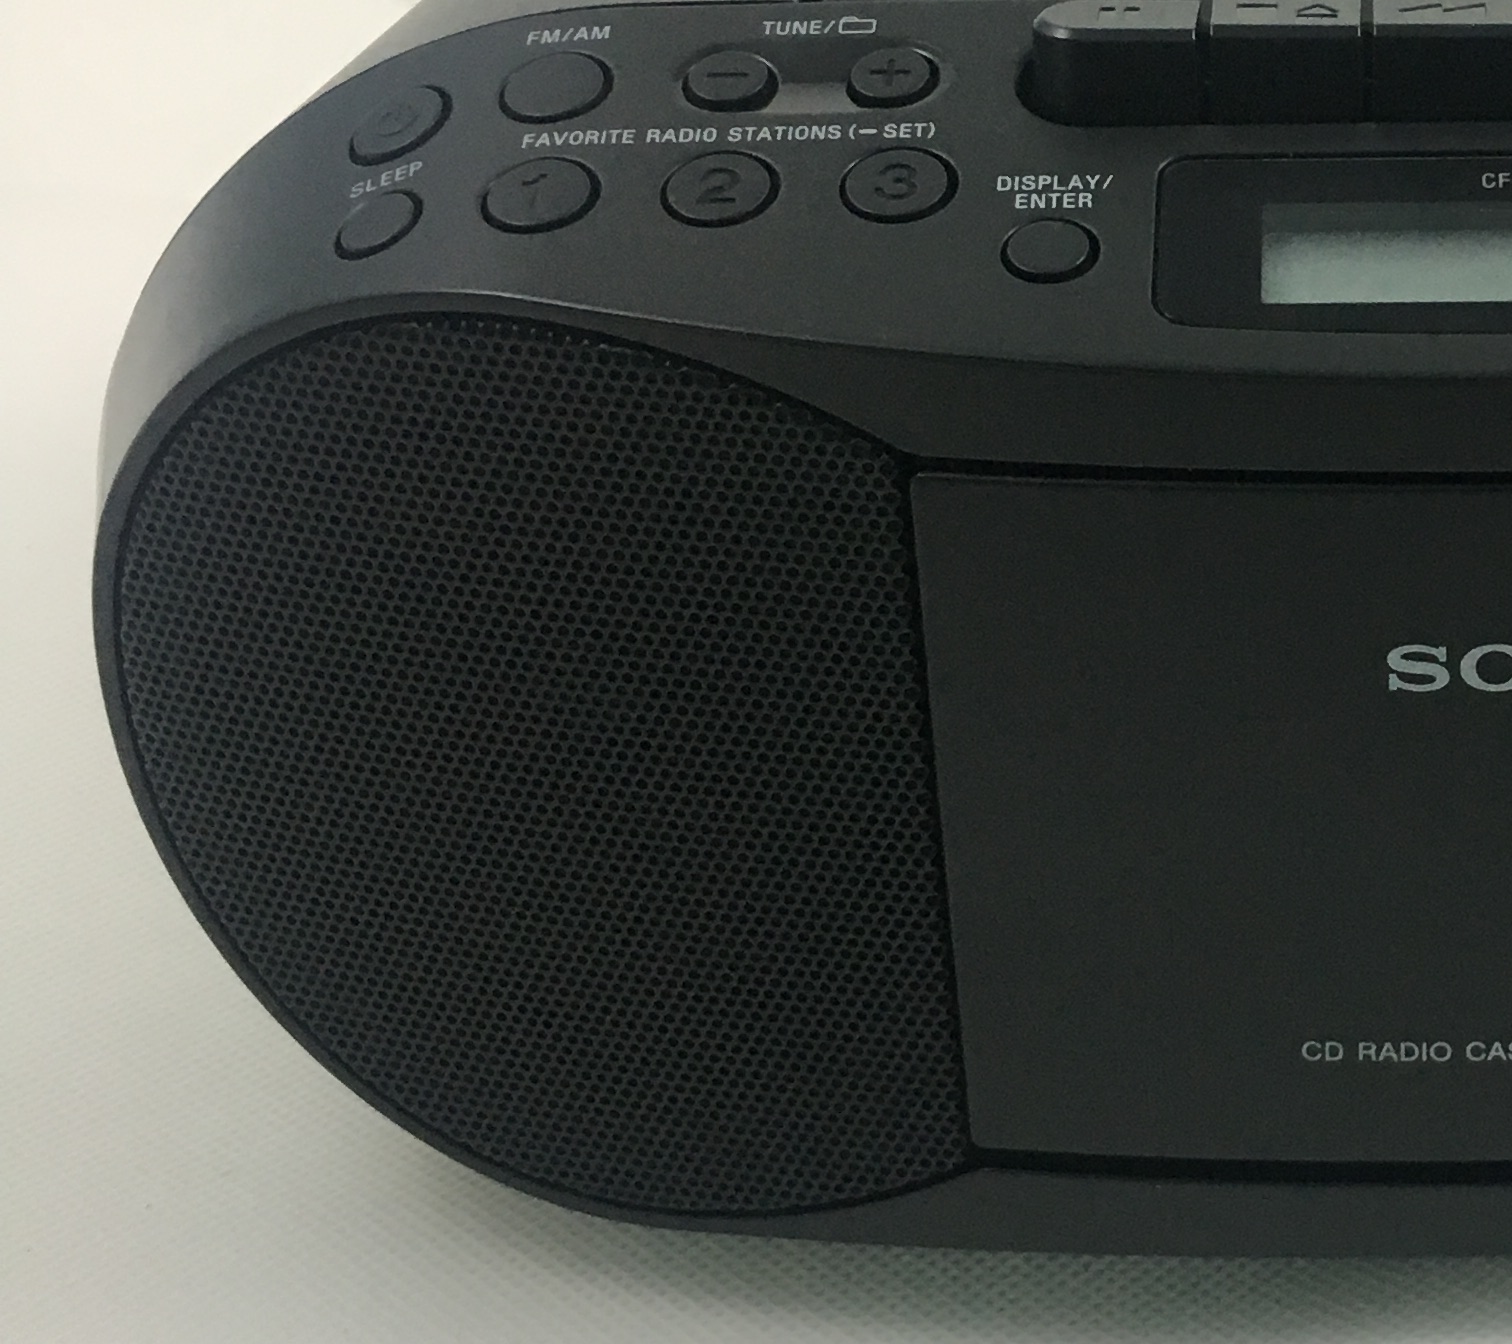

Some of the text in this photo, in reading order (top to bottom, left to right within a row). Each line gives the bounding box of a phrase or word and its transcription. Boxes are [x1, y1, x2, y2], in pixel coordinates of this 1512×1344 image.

[526, 25, 611, 45] FM/AM
[521, 128, 636, 149] FAVORITE
[645, 127, 717, 143] RADIO
[727, 124, 842, 142] STATIONS
[350, 161, 423, 198] SLEEP
[696, 167, 741, 204] 2
[874, 162, 918, 200] 3
[996, 174, 1114, 191] DISPLAY/
[1014, 192, 1093, 209] ENTER
[1301, 1040, 1344, 1062] CD
[1358, 1041, 1452, 1062] RADIO
